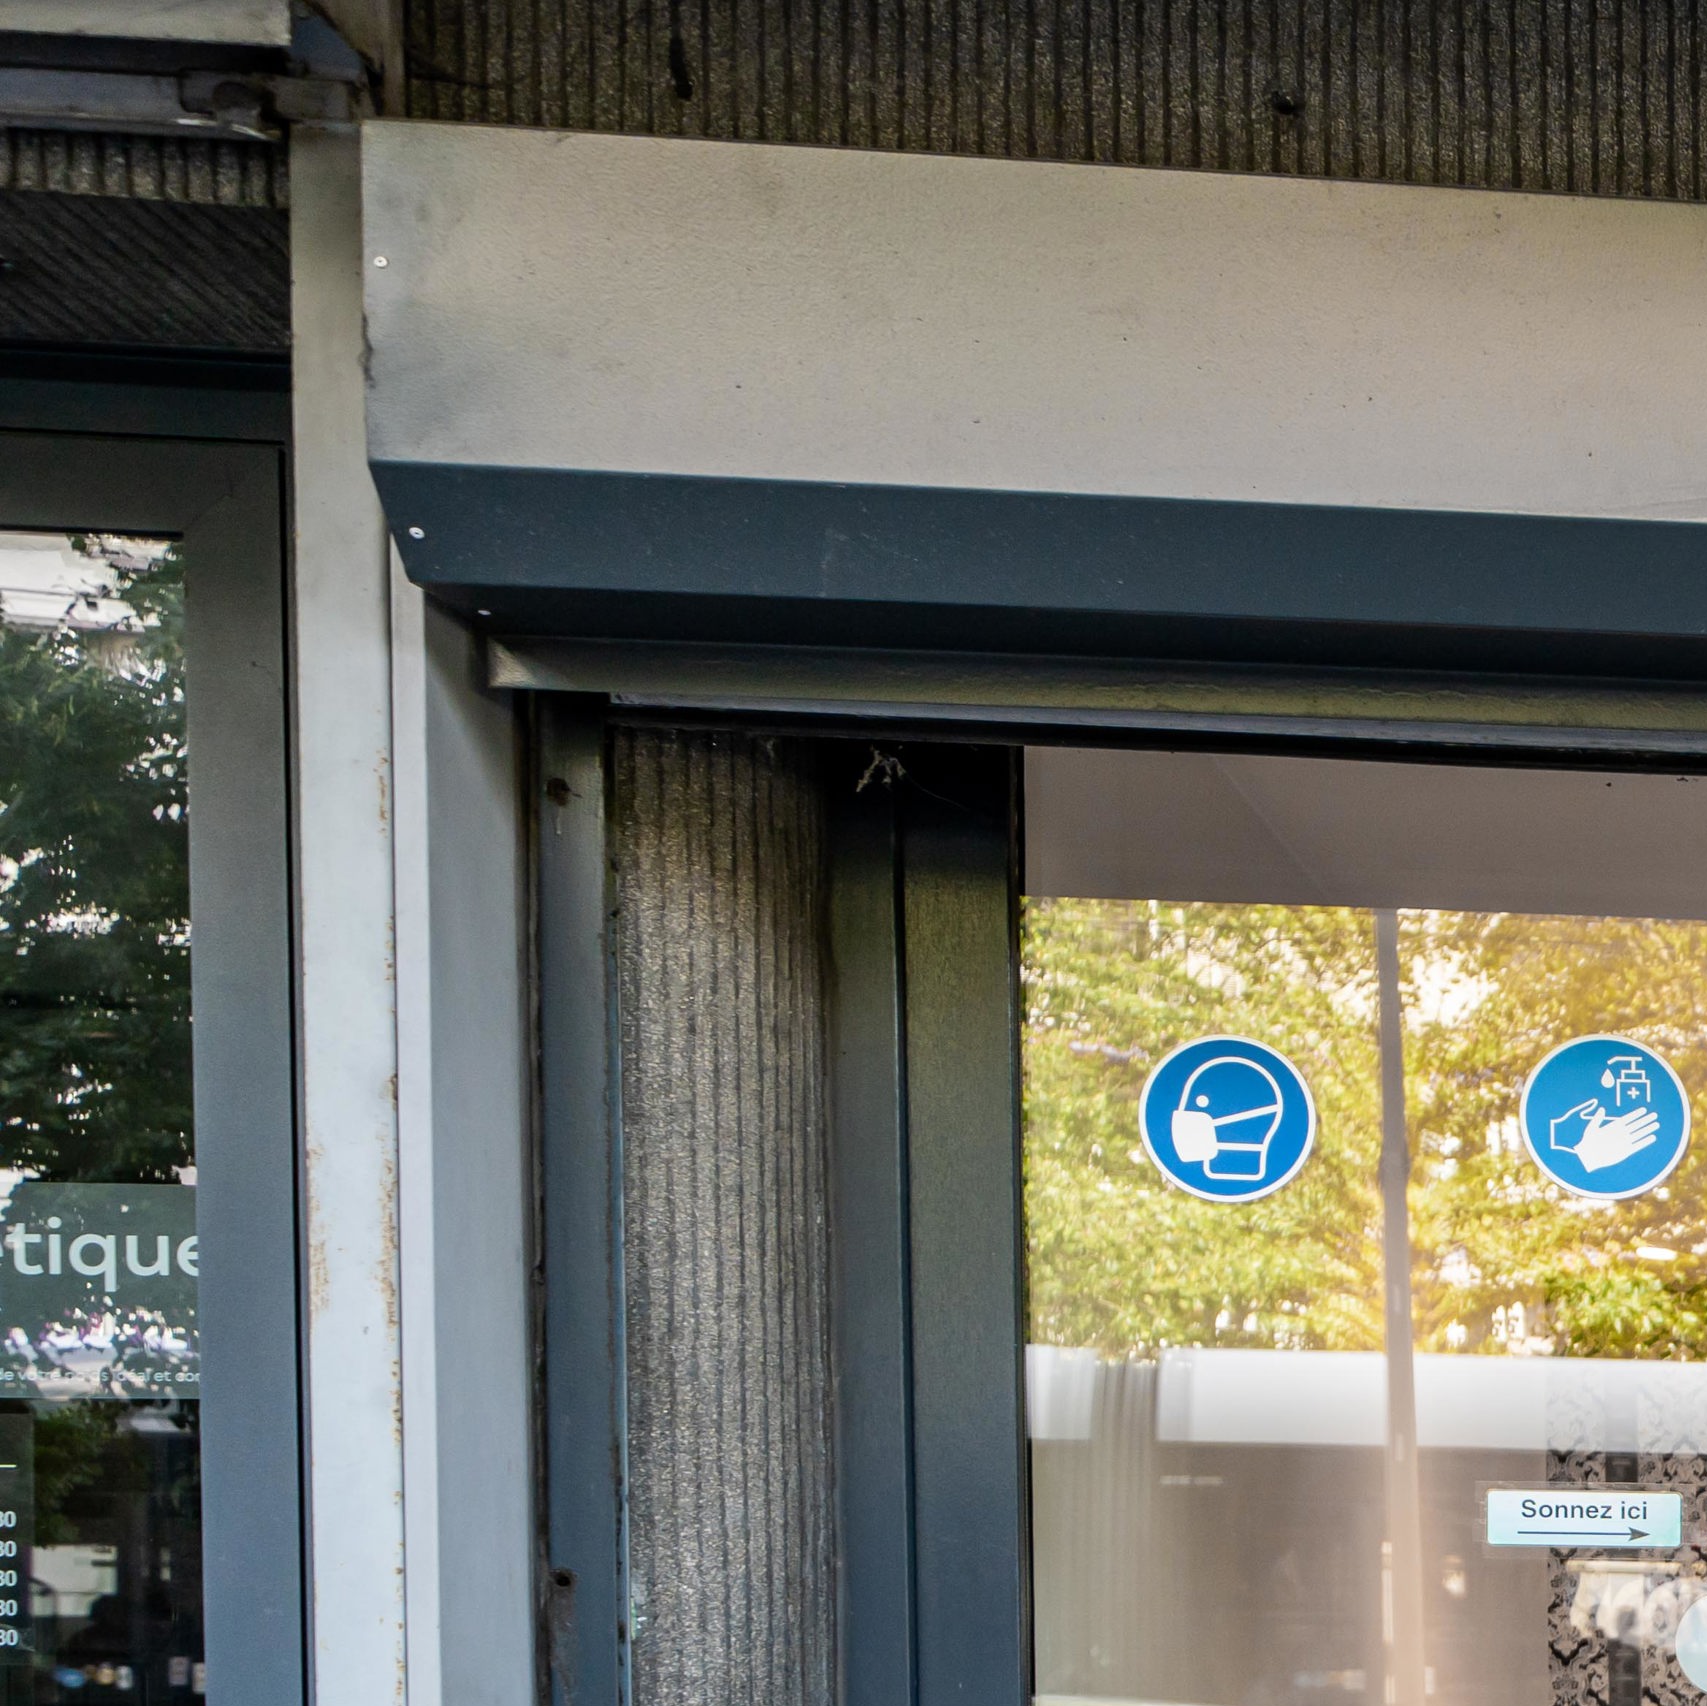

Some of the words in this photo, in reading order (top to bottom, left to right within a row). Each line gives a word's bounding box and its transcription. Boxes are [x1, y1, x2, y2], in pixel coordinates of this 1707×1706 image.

[154, 1369, 171, 1382] et
[1521, 1499, 1612, 1520] Sonnez
[1621, 1501, 1648, 1520] ici
